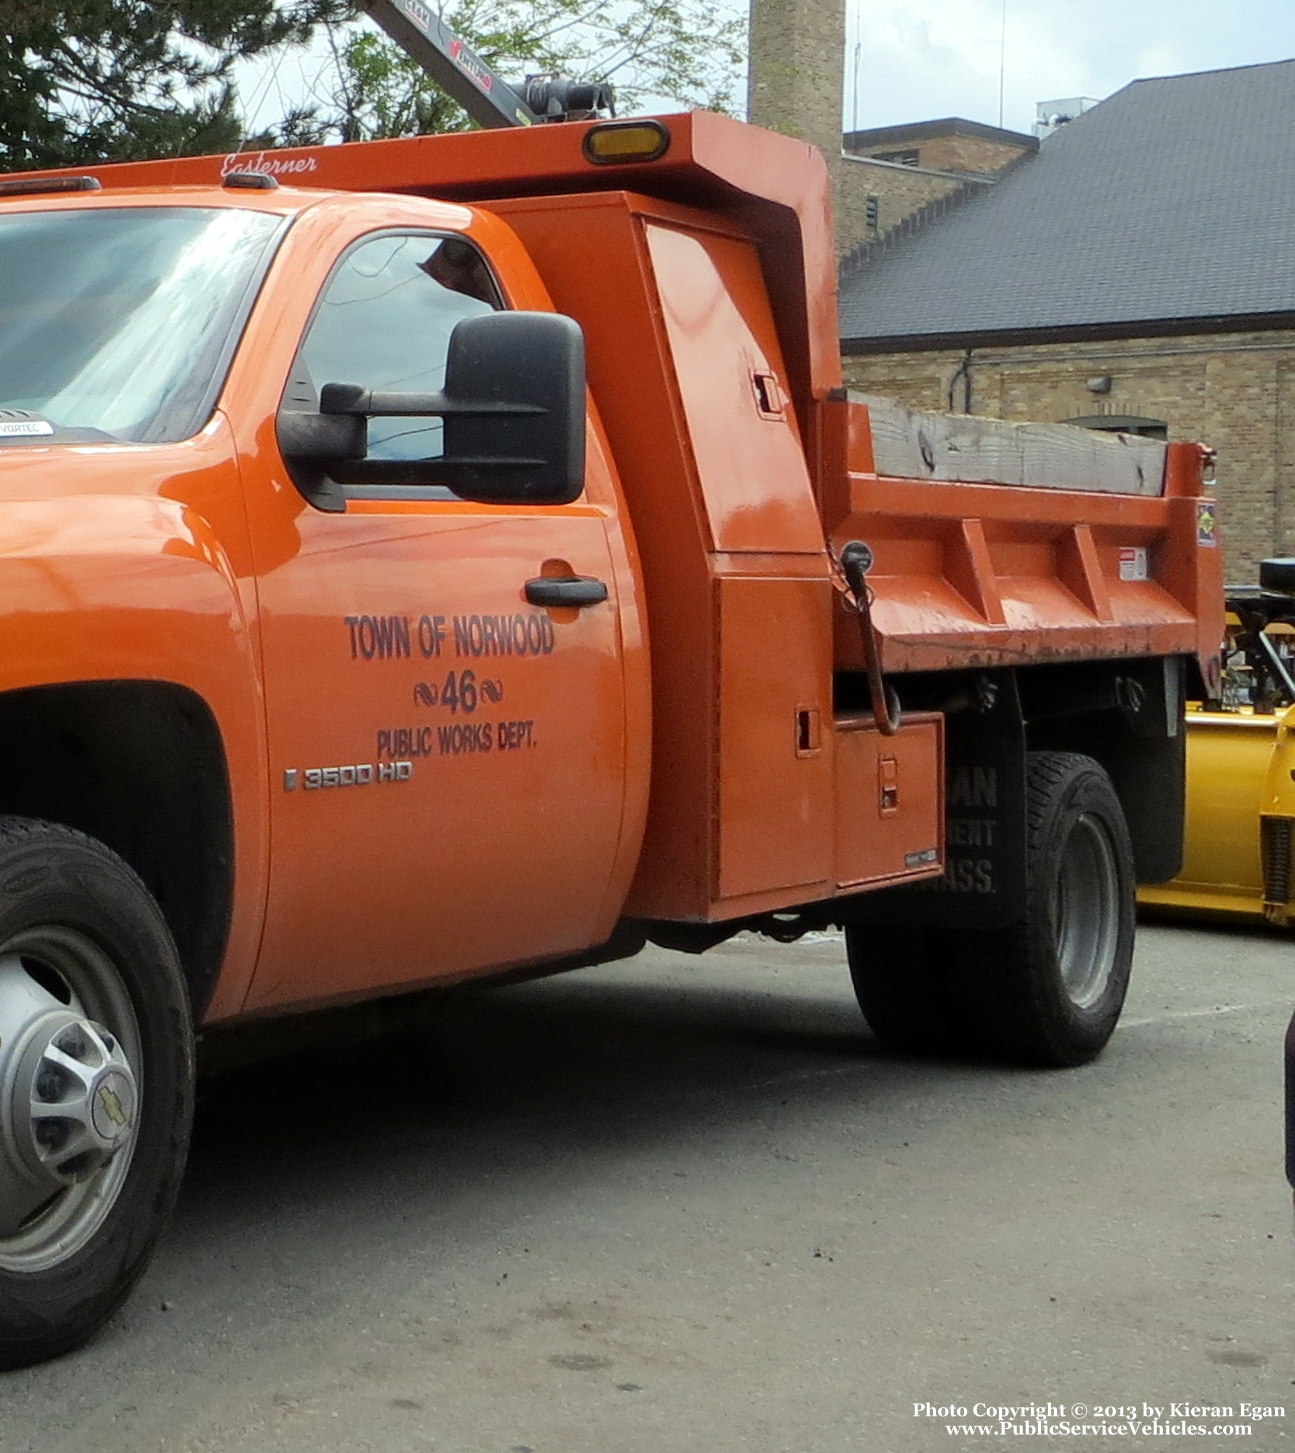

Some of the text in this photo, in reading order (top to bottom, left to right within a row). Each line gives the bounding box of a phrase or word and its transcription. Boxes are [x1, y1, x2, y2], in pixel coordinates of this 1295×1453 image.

[220, 152, 318, 177] Easterner
[344, 614, 556, 660] TOWN OF NORWOOD
[440, 669, 478, 714] 46
[376, 719, 538, 759] PUBLIC WORKS DEPT.
[303, 761, 413, 790] 3500 HD
[933, 858, 998, 894] ASS.
